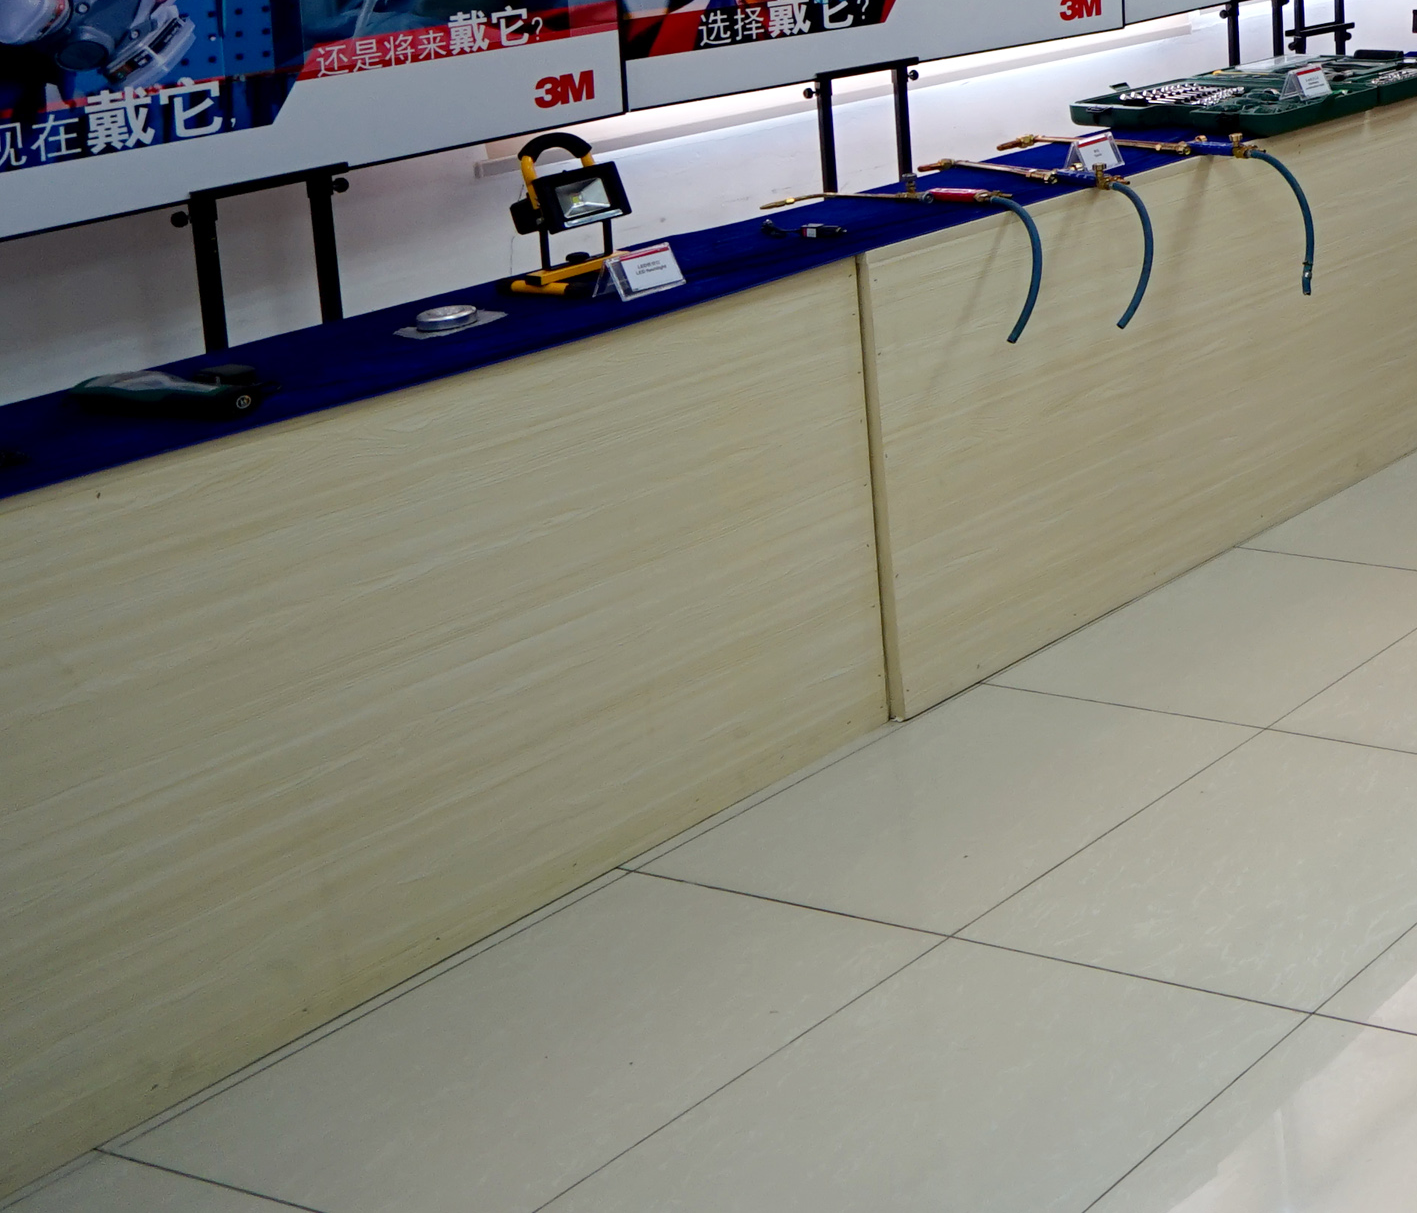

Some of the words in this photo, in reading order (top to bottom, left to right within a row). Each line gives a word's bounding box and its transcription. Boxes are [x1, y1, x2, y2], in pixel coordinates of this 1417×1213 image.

[316, 4, 543, 78] 还是将来戴它？
[534, 69, 595, 109] 3M
